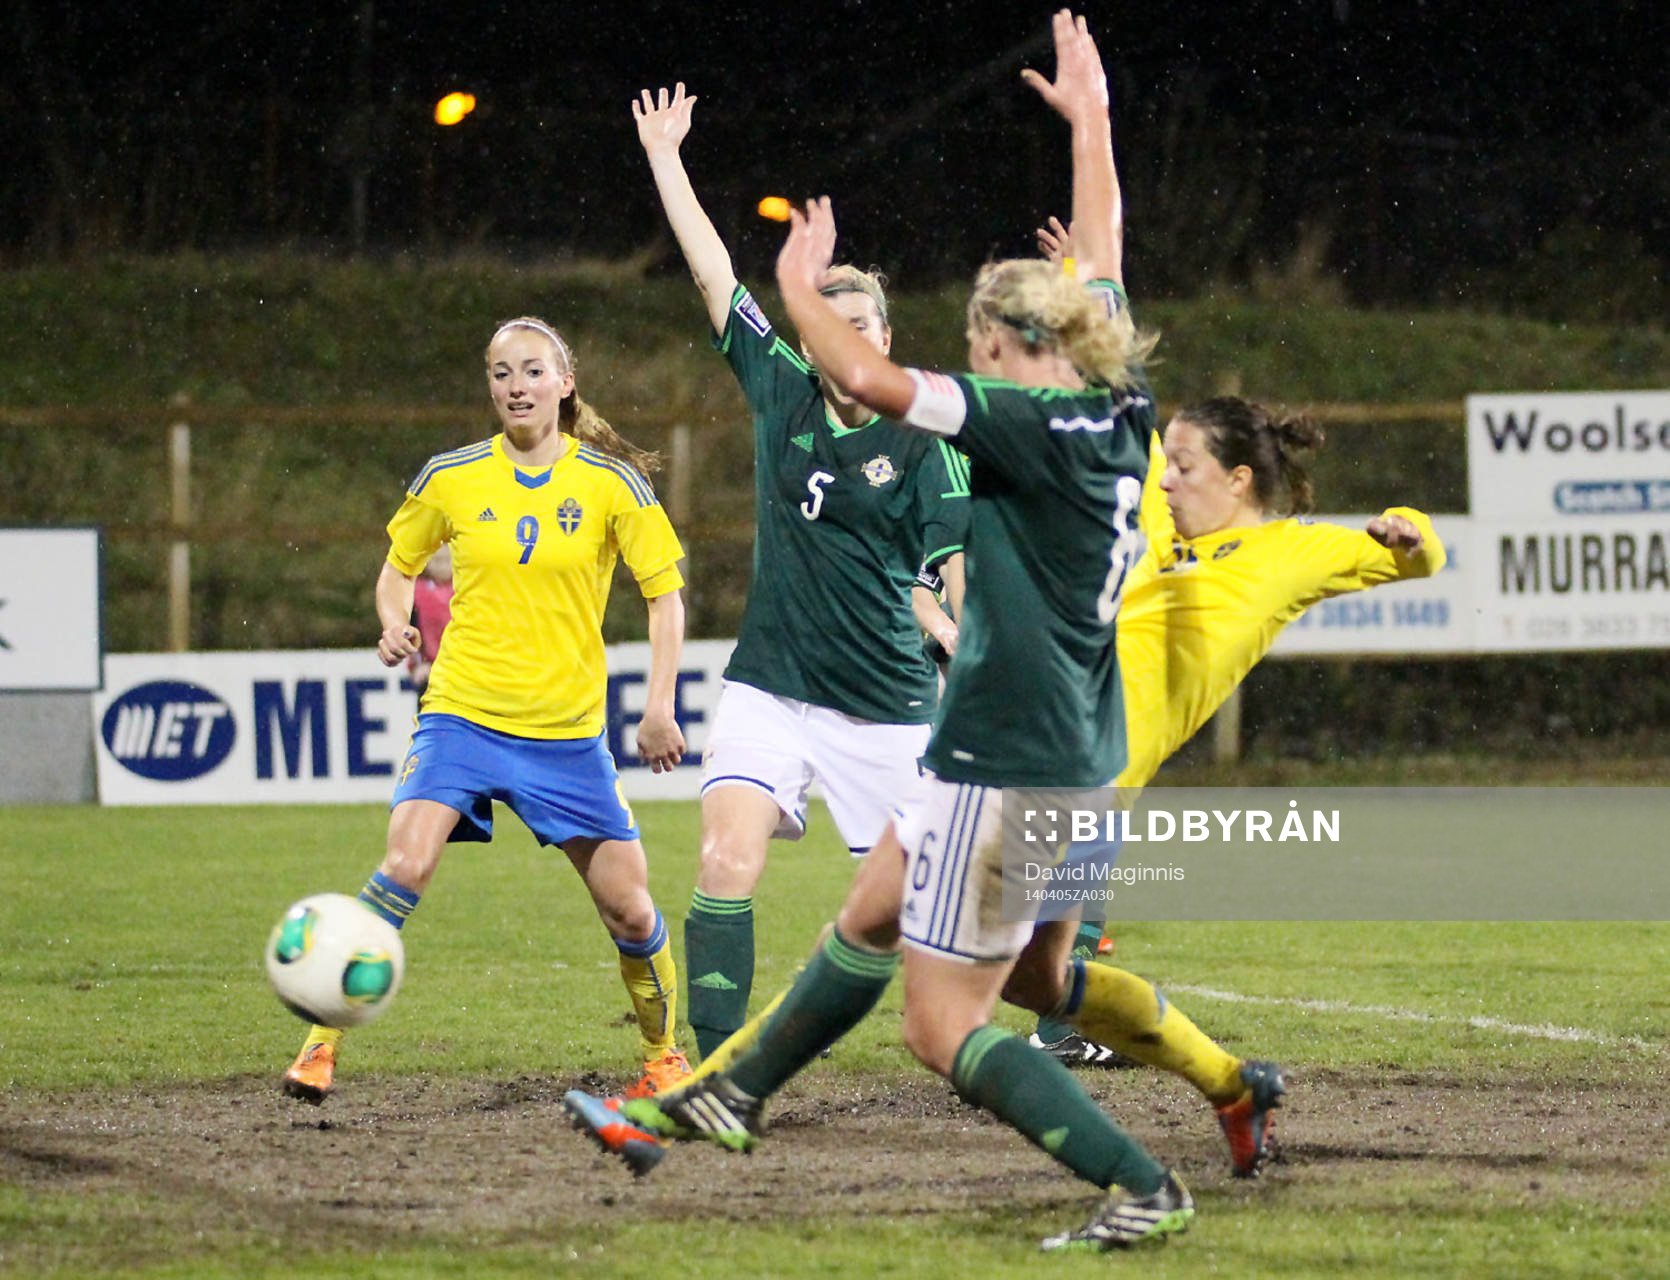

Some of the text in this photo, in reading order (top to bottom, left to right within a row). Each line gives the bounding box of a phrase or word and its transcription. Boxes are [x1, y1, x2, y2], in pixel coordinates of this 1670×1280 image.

[800, 470, 836, 522] 5
[515, 514, 540, 565] 9
[1500, 532, 1670, 594] MURRA
[111, 701, 228, 759] MET
[912, 829, 937, 891] 6
